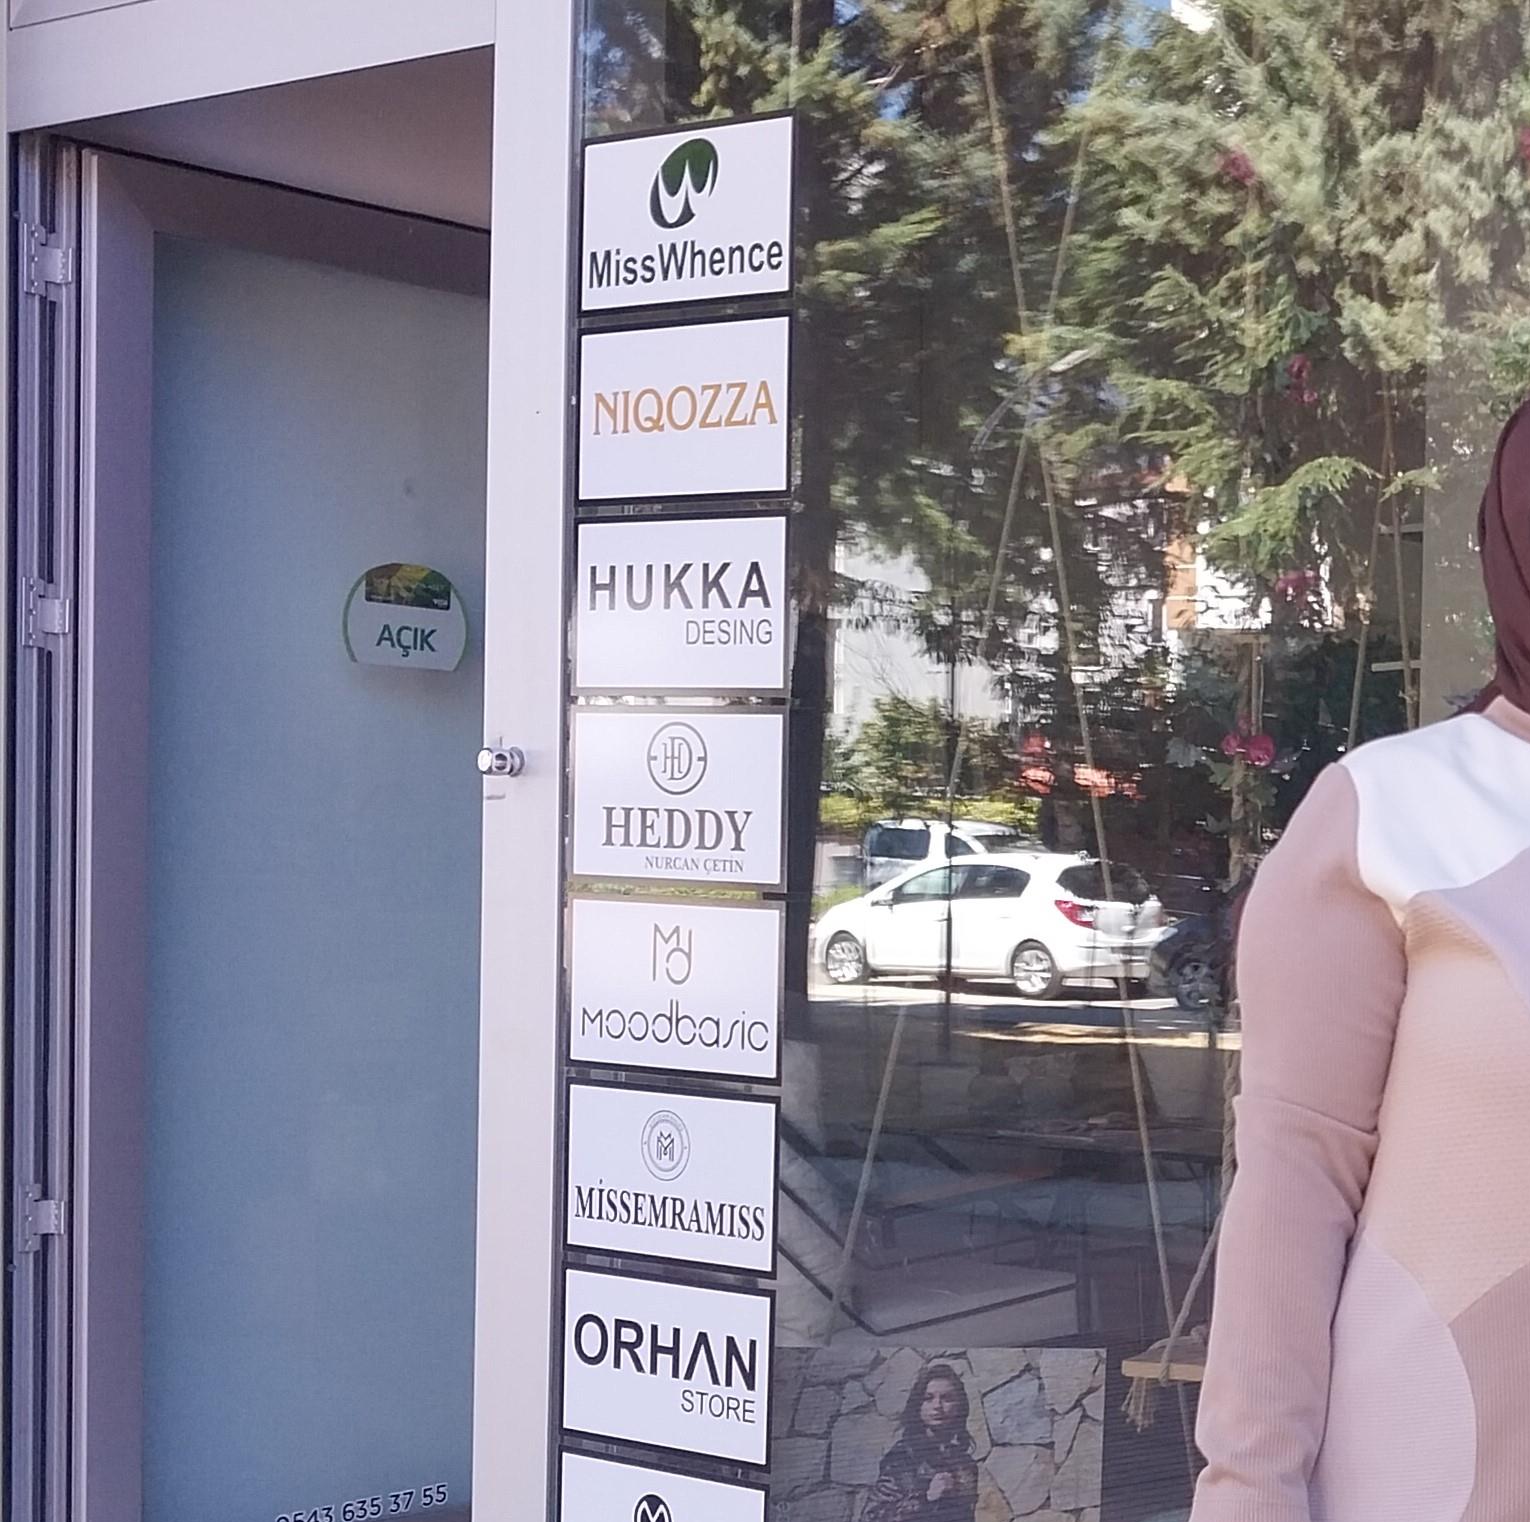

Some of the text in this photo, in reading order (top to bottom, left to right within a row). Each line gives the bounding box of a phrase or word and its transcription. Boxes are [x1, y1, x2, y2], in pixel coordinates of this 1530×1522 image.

[588, 241, 783, 289] MissWhence
[592, 380, 778, 436] NIQOZZA
[588, 561, 773, 612] HUKKA
[375, 623, 437, 658] AÇIK
[685, 619, 773, 645] DESING
[601, 806, 752, 852] HEDDY
[644, 855, 744, 875] NURCAN ÇETİN
[574, 1179, 766, 1242] MİSSEMRAMISS
[574, 1313, 757, 1391] ORHAN
[680, 1389, 756, 1424] STORE
[341, 1496, 382, 1522] 635
[389, 1489, 416, 1514] 37
[421, 1482, 449, 1508] 55
